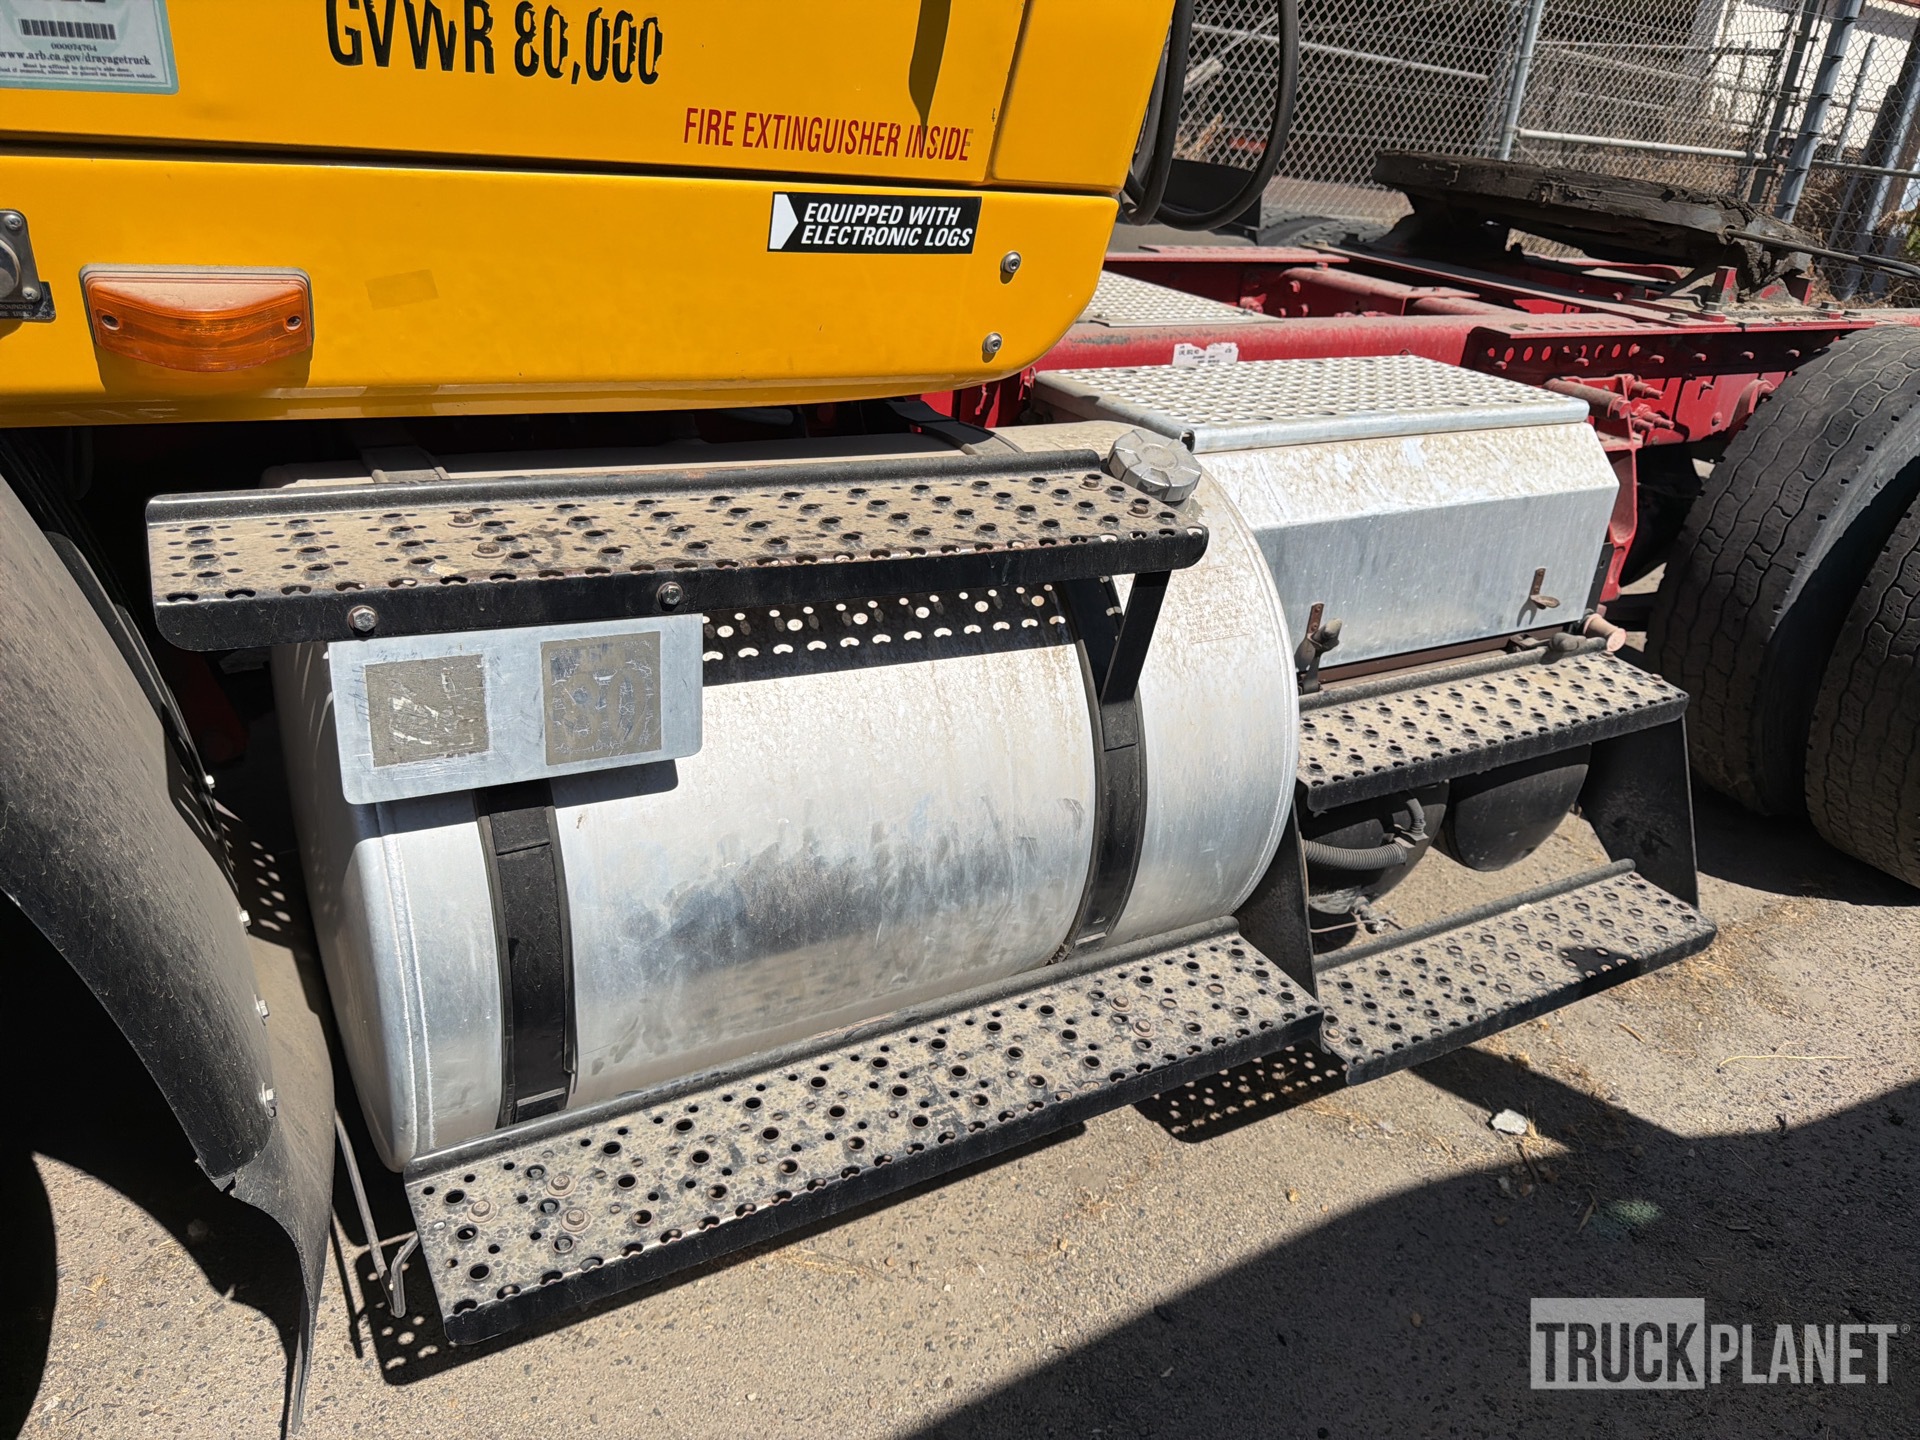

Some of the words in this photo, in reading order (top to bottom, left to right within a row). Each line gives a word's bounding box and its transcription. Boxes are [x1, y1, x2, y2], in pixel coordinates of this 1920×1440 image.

[326, 0, 495, 75] GVWR
[514, 1, 663, 86] 80,000
[0, 50, 152, 66] www.arb.ca.gov/drayagetruck
[683, 107, 737, 147] FIRE
[742, 112, 902, 158] EXTINGUISHER
[904, 124, 974, 162] INSIDE
[803, 202, 904, 226] EQUIPPED
[908, 206, 962, 226] WITH
[800, 225, 924, 247] ELECTRONIC
[923, 227, 974, 248] LOGS
